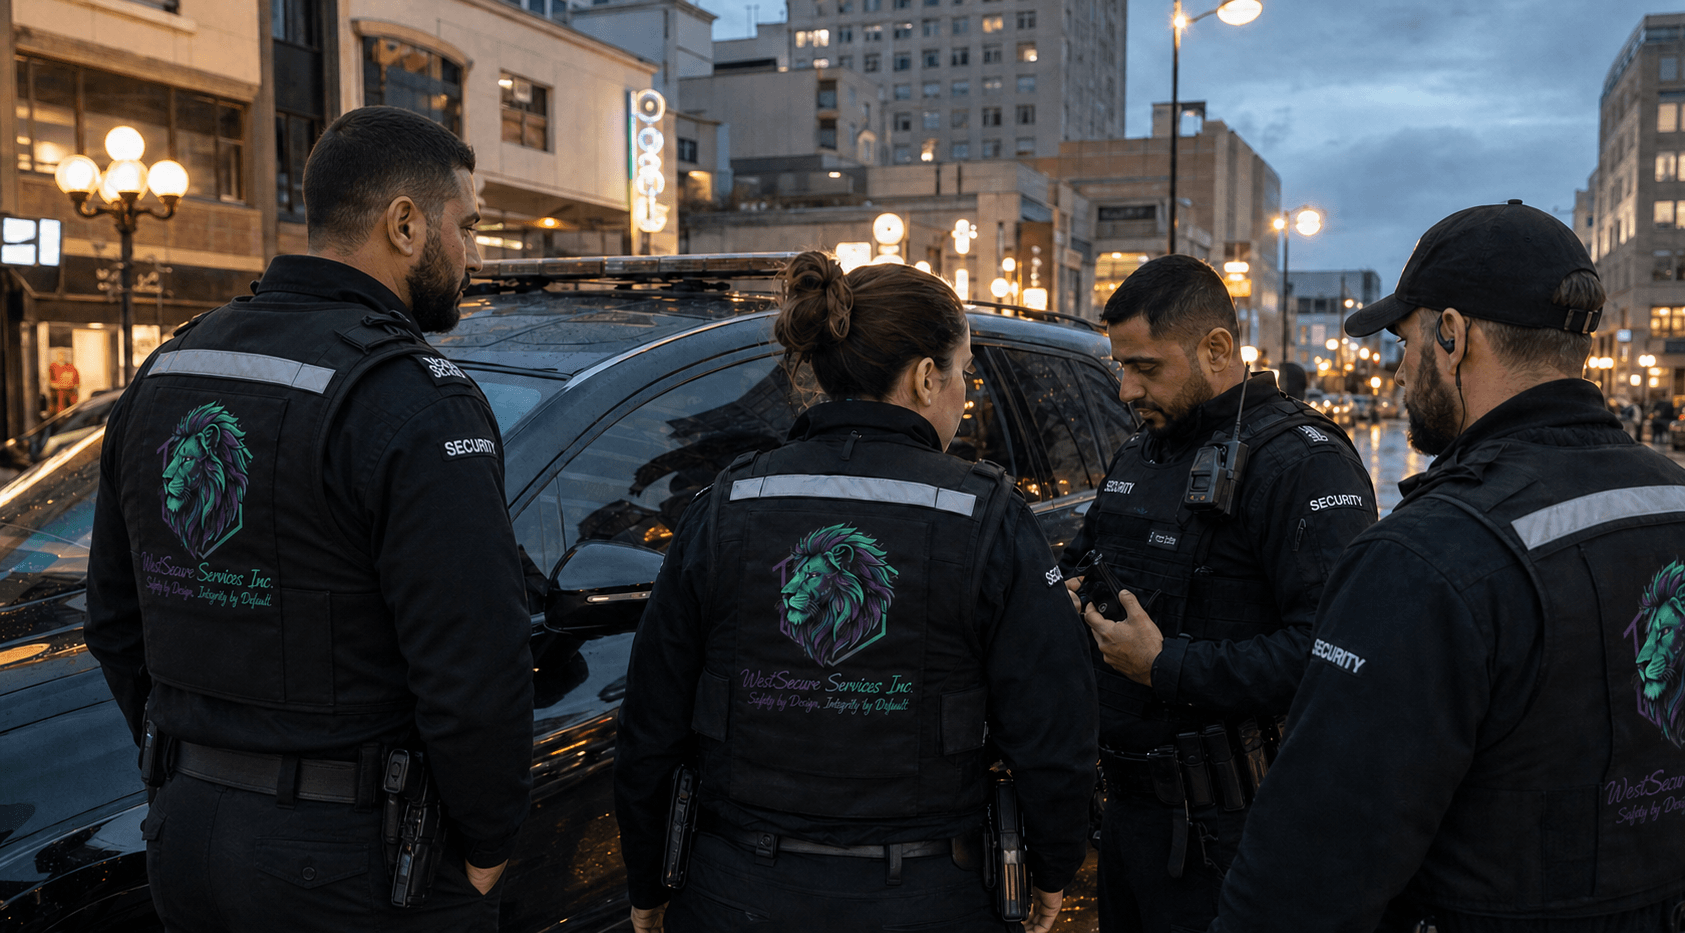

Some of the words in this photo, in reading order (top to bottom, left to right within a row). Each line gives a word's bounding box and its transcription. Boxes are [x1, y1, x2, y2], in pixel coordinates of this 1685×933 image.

[444, 438, 496, 456] SECURITY
[1104, 480, 1135, 495] SECURITY
[1310, 494, 1362, 511] SECURITY
[197, 562, 244, 586] Services
[247, 569, 273, 588] Inc.
[229, 589, 239, 608] by
[1312, 638, 1366, 673] SECURITY
[740, 669, 821, 690] WestSecure
[825, 672, 883, 693] Services
[886, 674, 914, 695] Inc.
[776, 693, 788, 712] by
[823, 696, 860, 715] Integrity
[862, 696, 873, 716] by
[1650, 801, 1661, 822] by
